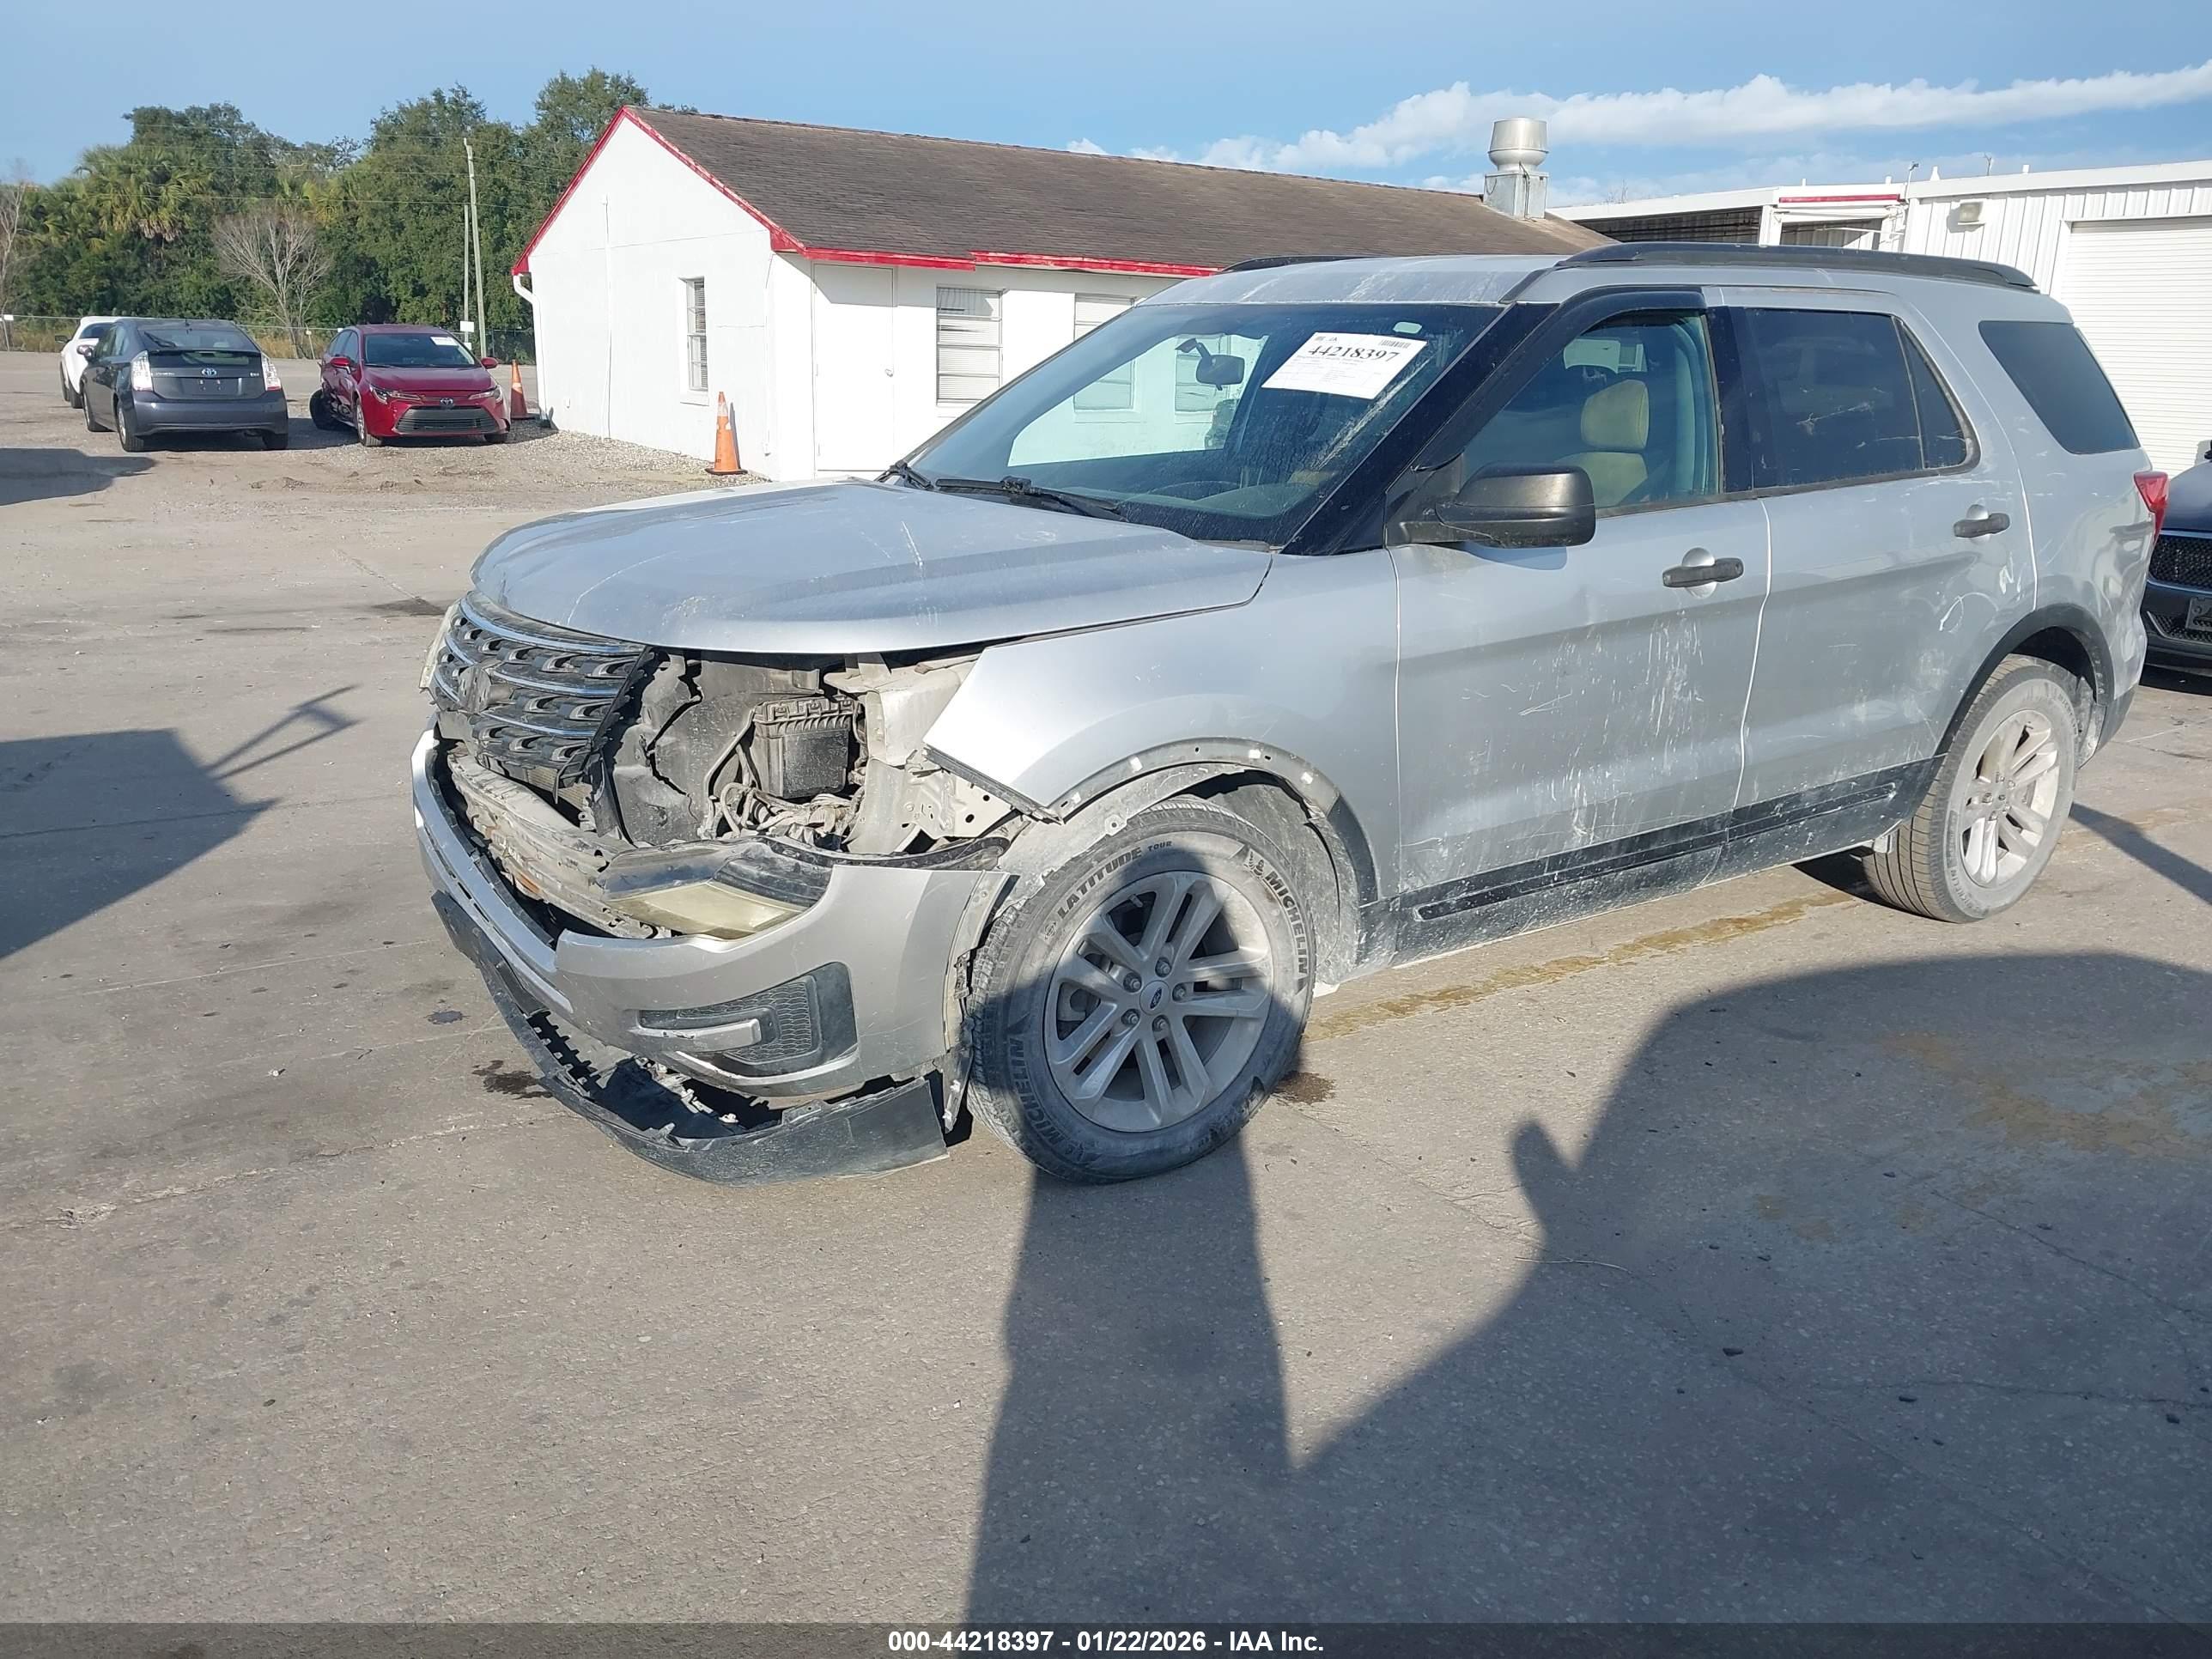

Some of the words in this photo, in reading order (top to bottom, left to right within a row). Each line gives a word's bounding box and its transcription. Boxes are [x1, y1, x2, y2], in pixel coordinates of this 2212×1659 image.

[1308, 345, 1401, 362] 44218397
[1057, 846, 1142, 919] LATITUDE
[1147, 841, 1173, 853] TOUR
[1265, 870, 1309, 975] MICHELIN
[1009, 1037, 1066, 1146] MICHELIN
